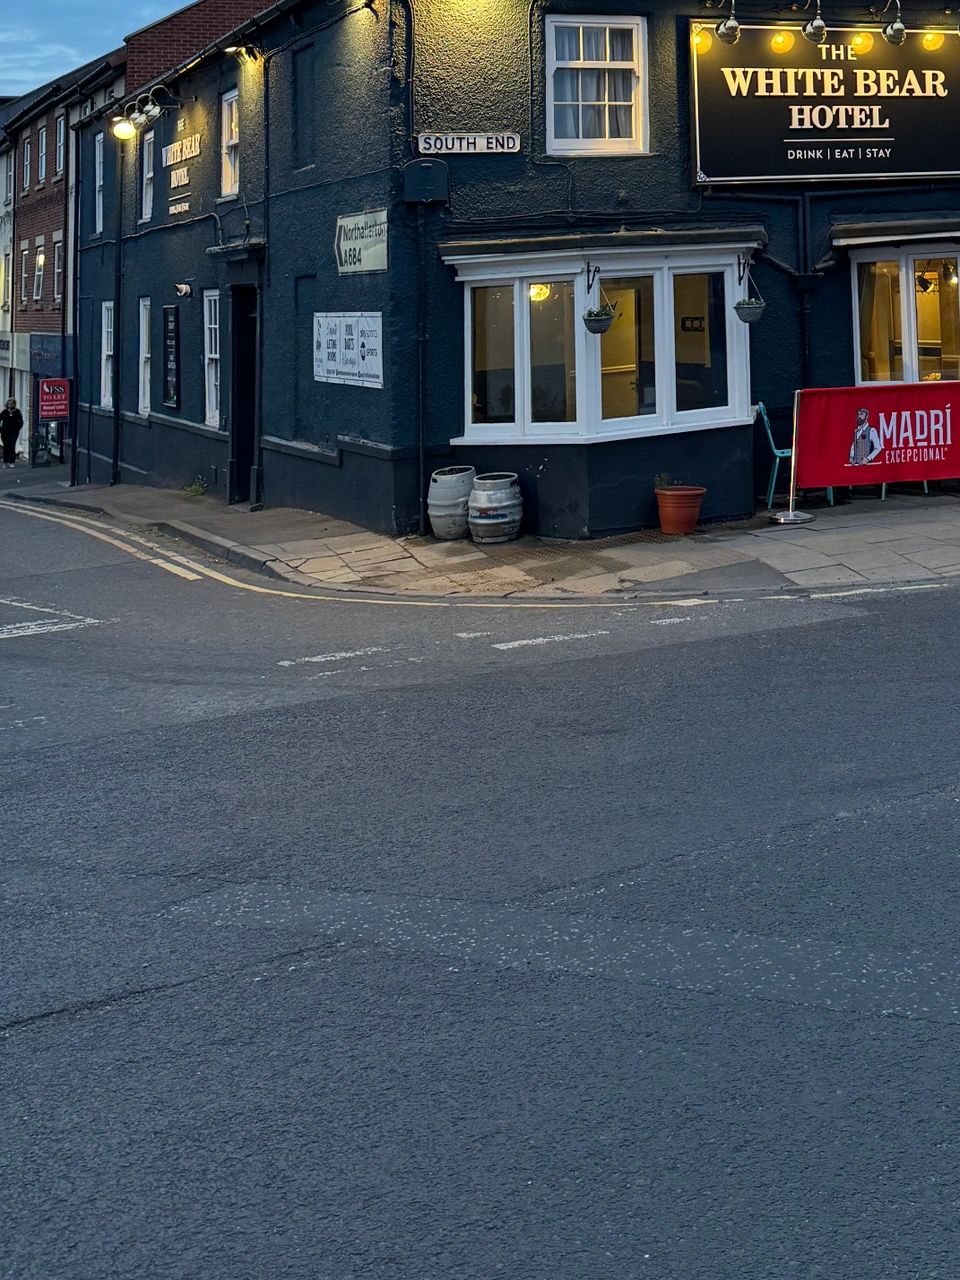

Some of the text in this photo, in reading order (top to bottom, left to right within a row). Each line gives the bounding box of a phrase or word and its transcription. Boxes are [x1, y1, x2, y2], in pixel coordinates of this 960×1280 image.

[818, 43, 857, 61] THE
[721, 67, 948, 98] WHITE BEAR
[789, 104, 890, 130] HOTEL
[423, 136, 516, 151] SOUTH END
[787, 147, 892, 159] DRINK EAT STAY
[344, 247, 362, 267] A684
[879, 403, 952, 449] MADRÍ
[885, 447, 945, 464] EXCEPCIONAL
